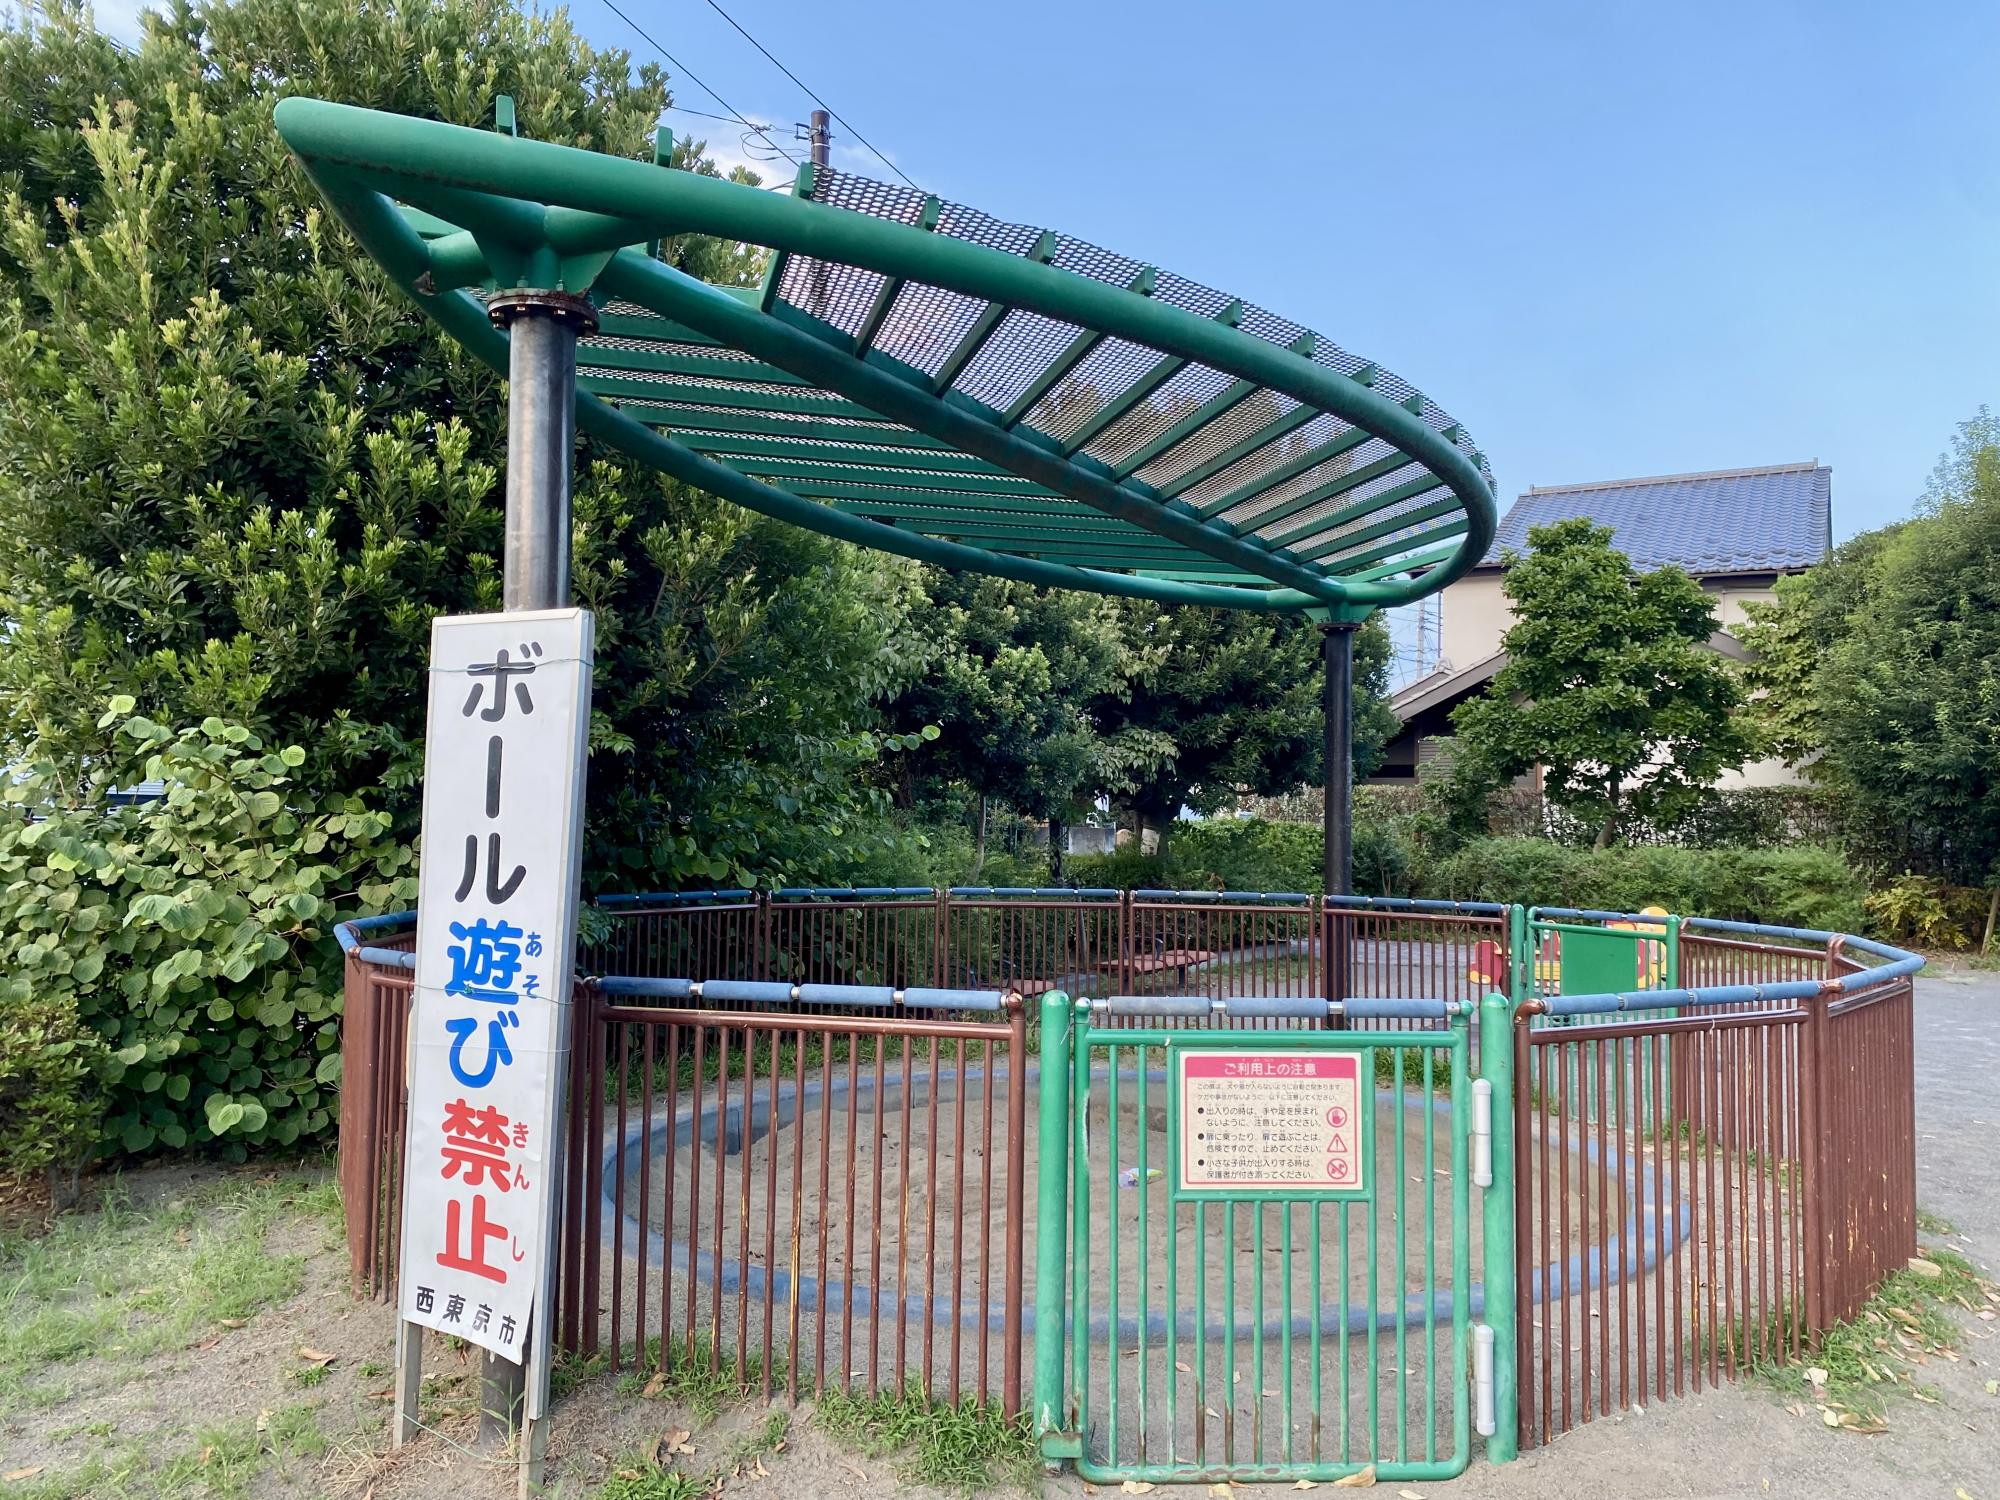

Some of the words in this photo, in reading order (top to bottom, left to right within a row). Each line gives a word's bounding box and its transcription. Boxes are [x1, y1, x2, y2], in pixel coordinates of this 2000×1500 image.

[436, 641, 543, 1284] ボール遊び禁止
[522, 931, 543, 999] あそ
[1224, 1063, 1318, 1076] ご利用上の注意
[416, 1285, 518, 1346] 西東京市
